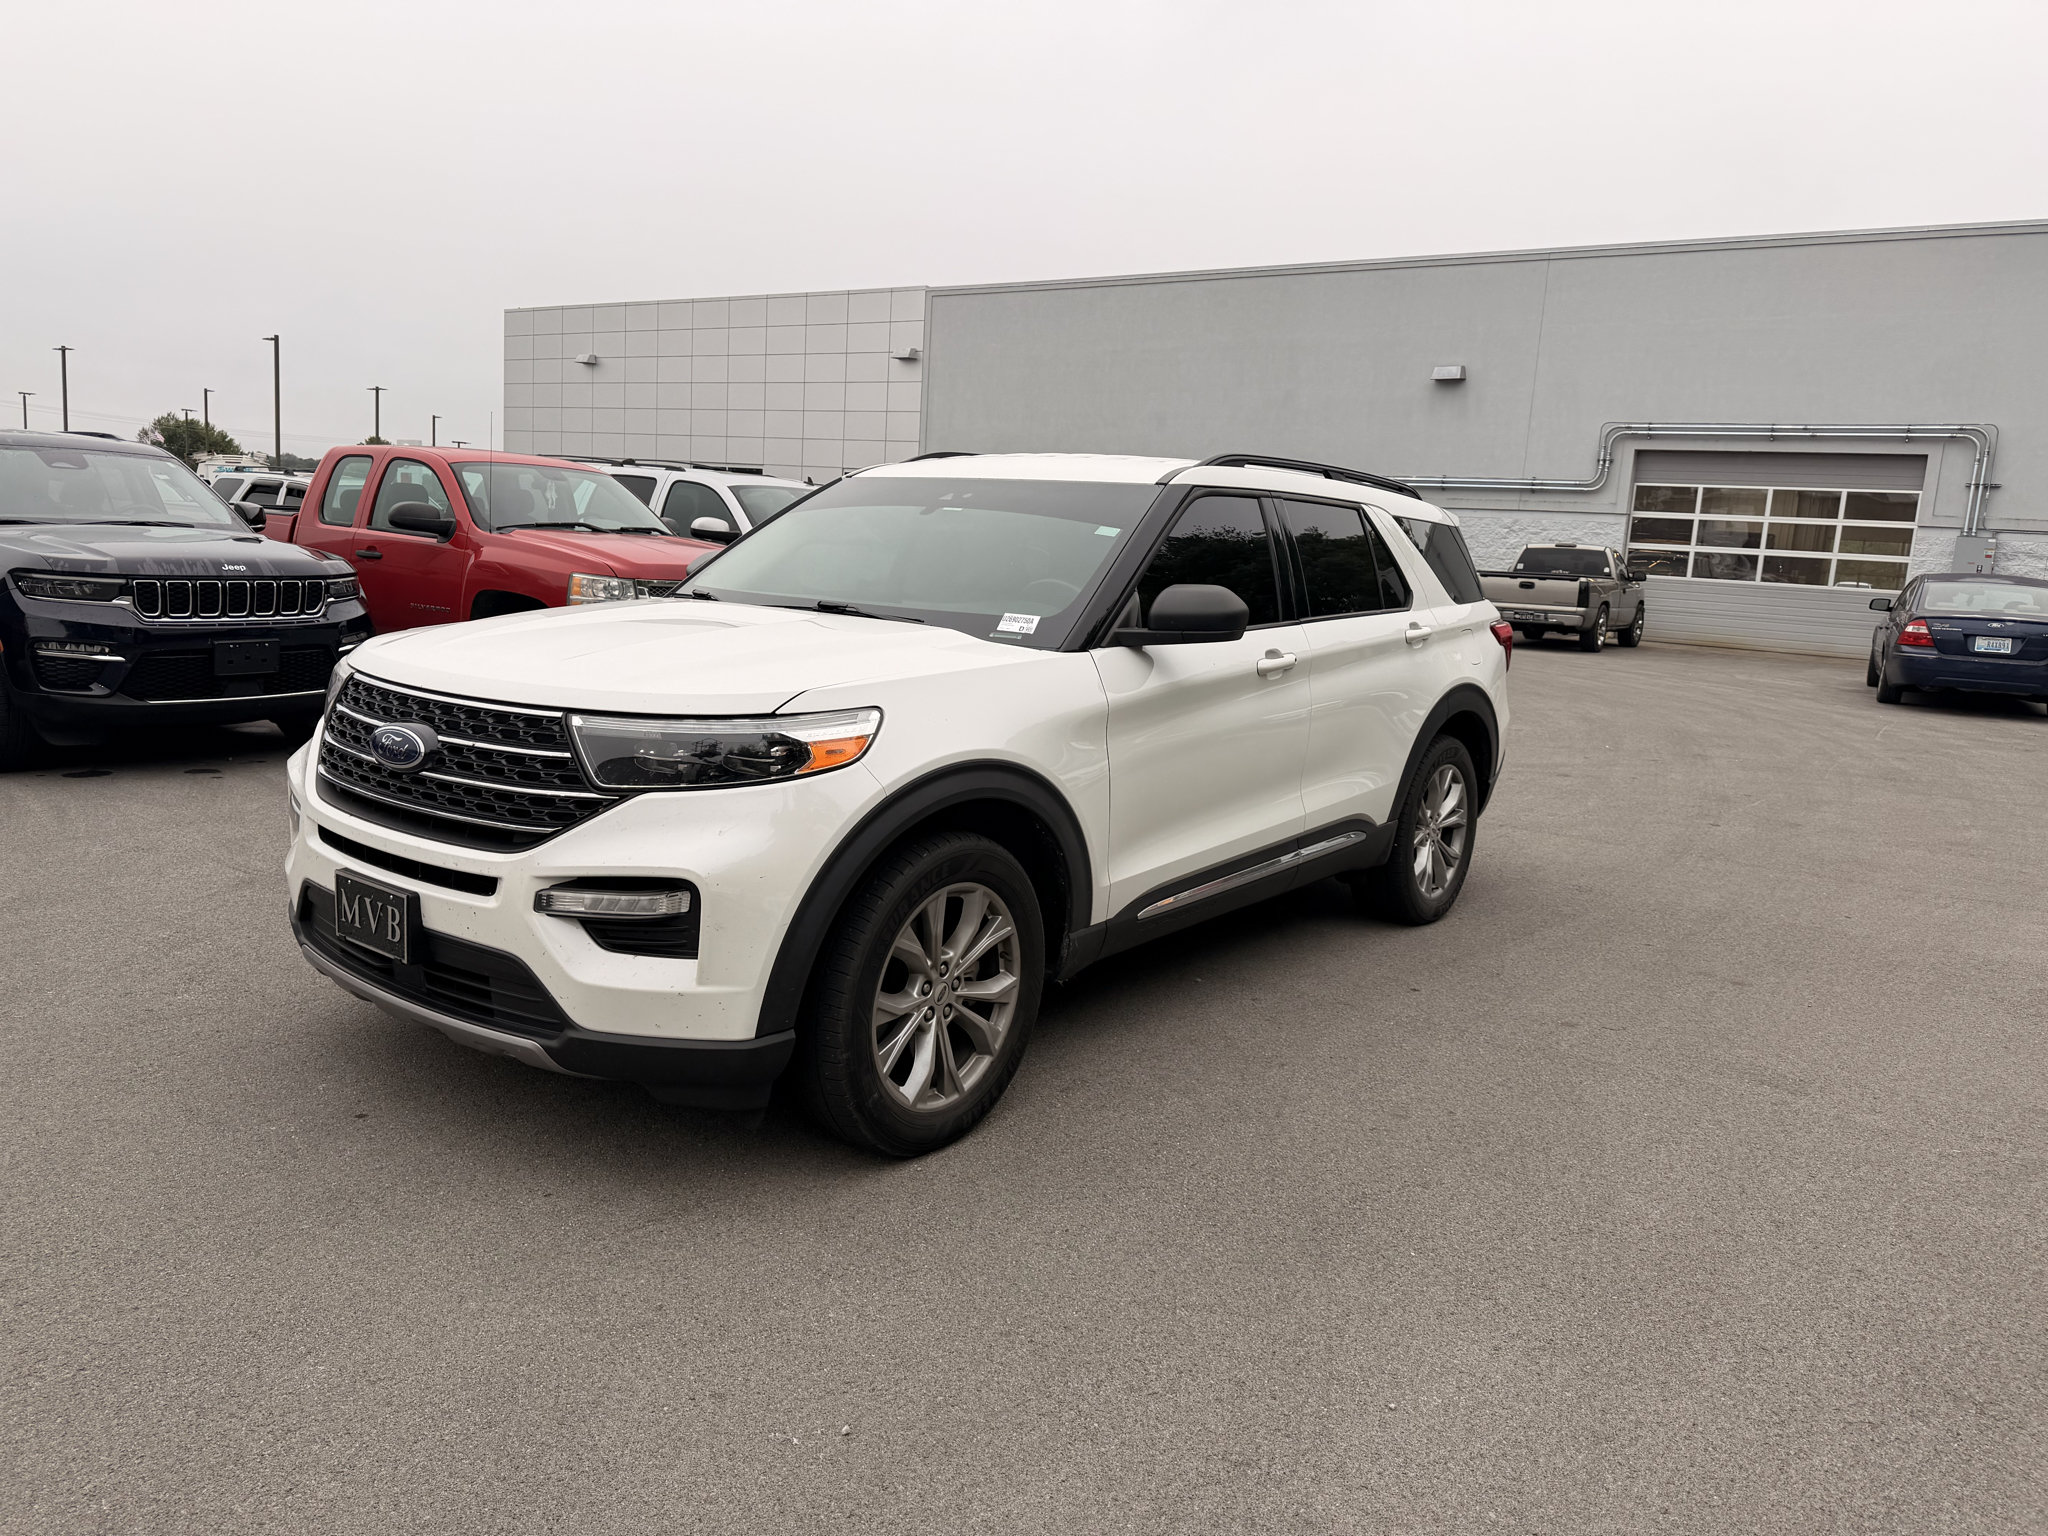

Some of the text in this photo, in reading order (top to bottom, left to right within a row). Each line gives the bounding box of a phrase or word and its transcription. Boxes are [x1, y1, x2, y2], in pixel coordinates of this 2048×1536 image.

[221, 563, 247, 572] Jeep
[379, 732, 409, 760] Ford
[340, 888, 402, 942] MVB
